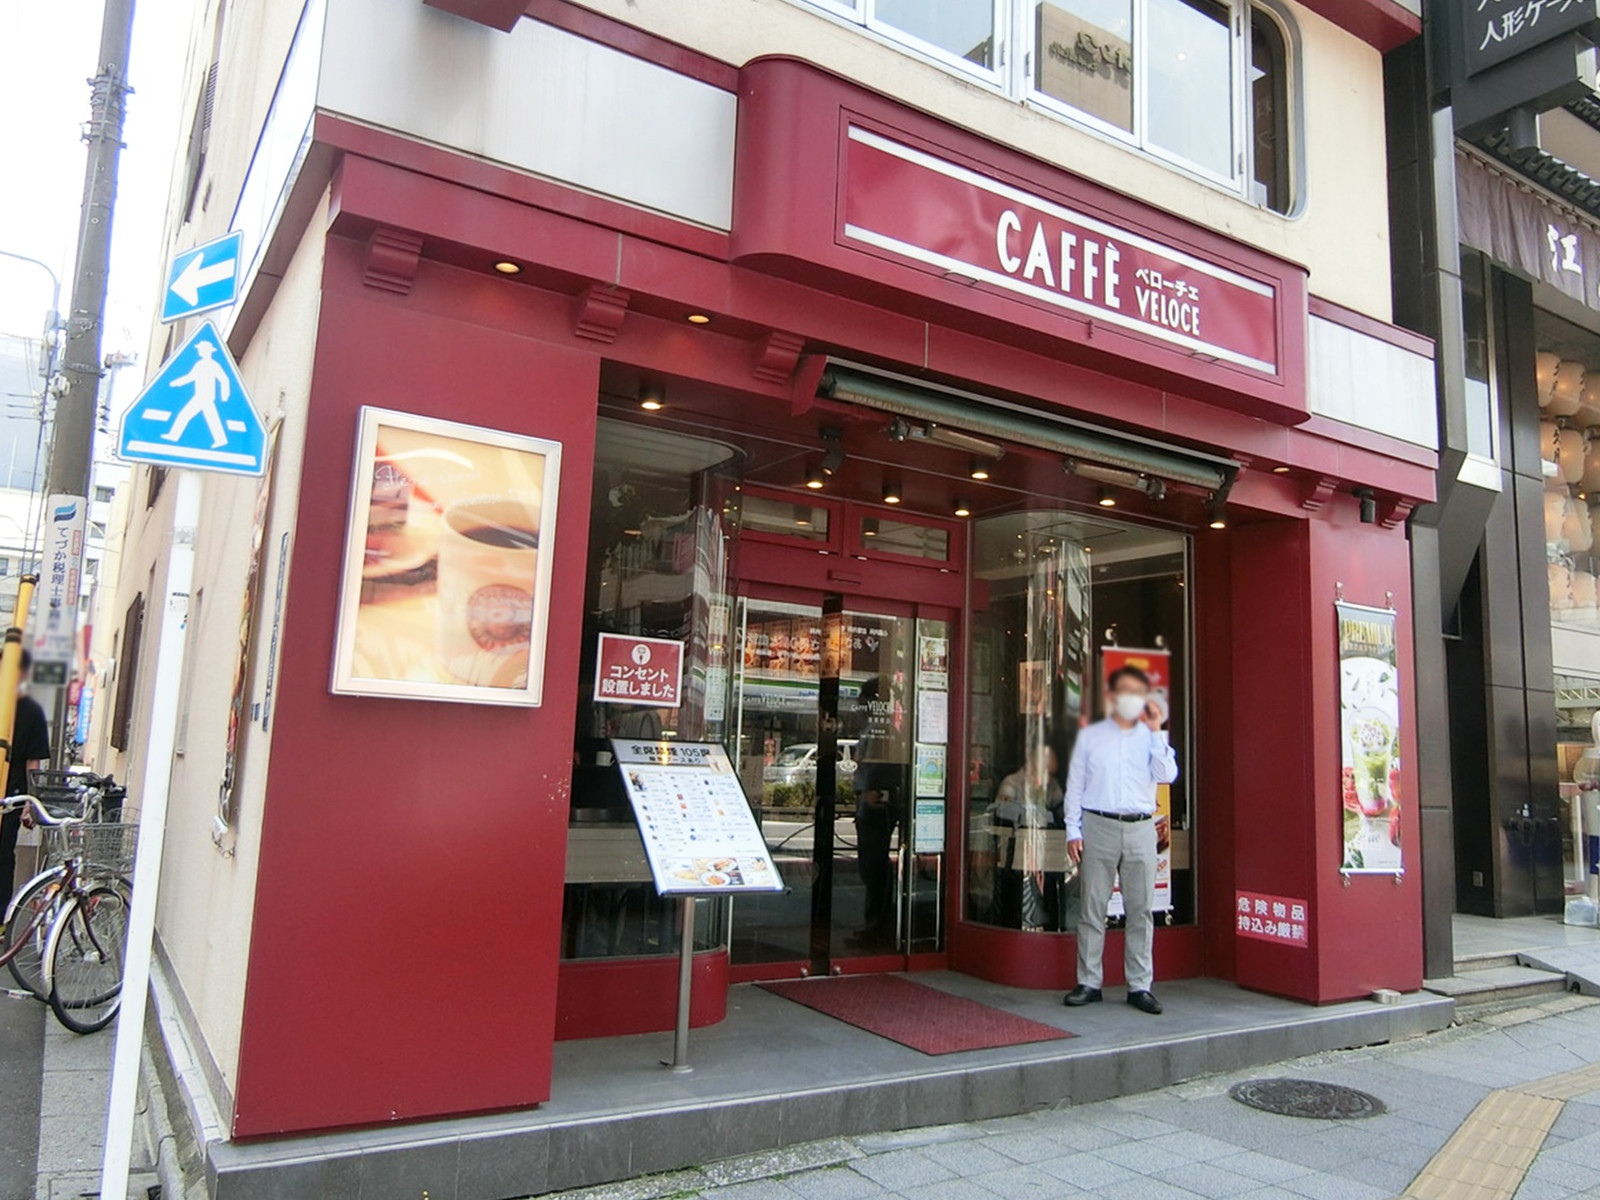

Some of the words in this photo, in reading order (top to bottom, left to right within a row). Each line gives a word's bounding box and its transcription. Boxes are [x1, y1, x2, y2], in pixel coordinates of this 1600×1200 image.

[996, 209, 1121, 310] CAFFÈ
[1135, 285, 1200, 336] VELOCE
[610, 665, 669, 682] コンセント
[602, 678, 674, 698] 設置しました
[1237, 896, 1305, 921] 危険物品
[1237, 915, 1305, 940] 持込み厳禁
